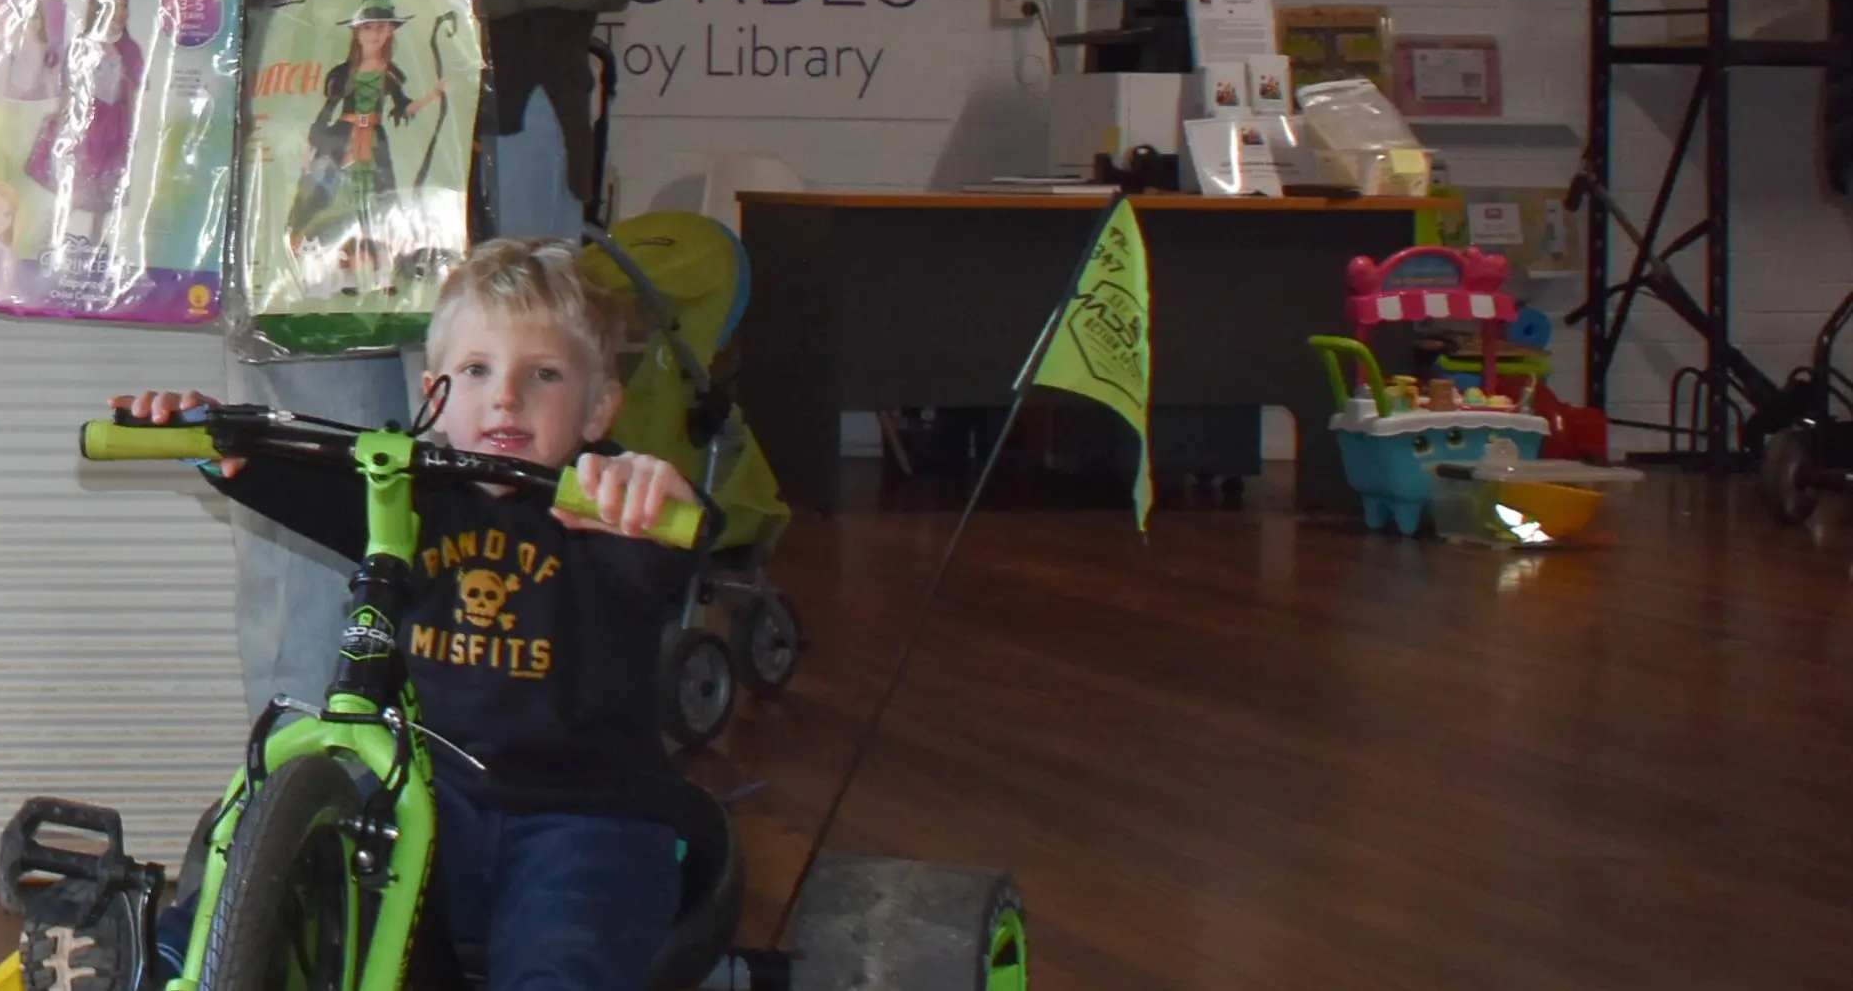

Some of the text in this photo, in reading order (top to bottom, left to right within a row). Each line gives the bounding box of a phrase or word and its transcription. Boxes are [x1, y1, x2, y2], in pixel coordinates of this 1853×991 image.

[595, 21, 885, 100] Toy Library
[517, 541, 561, 583] OF
[410, 623, 552, 673] MISFITS
